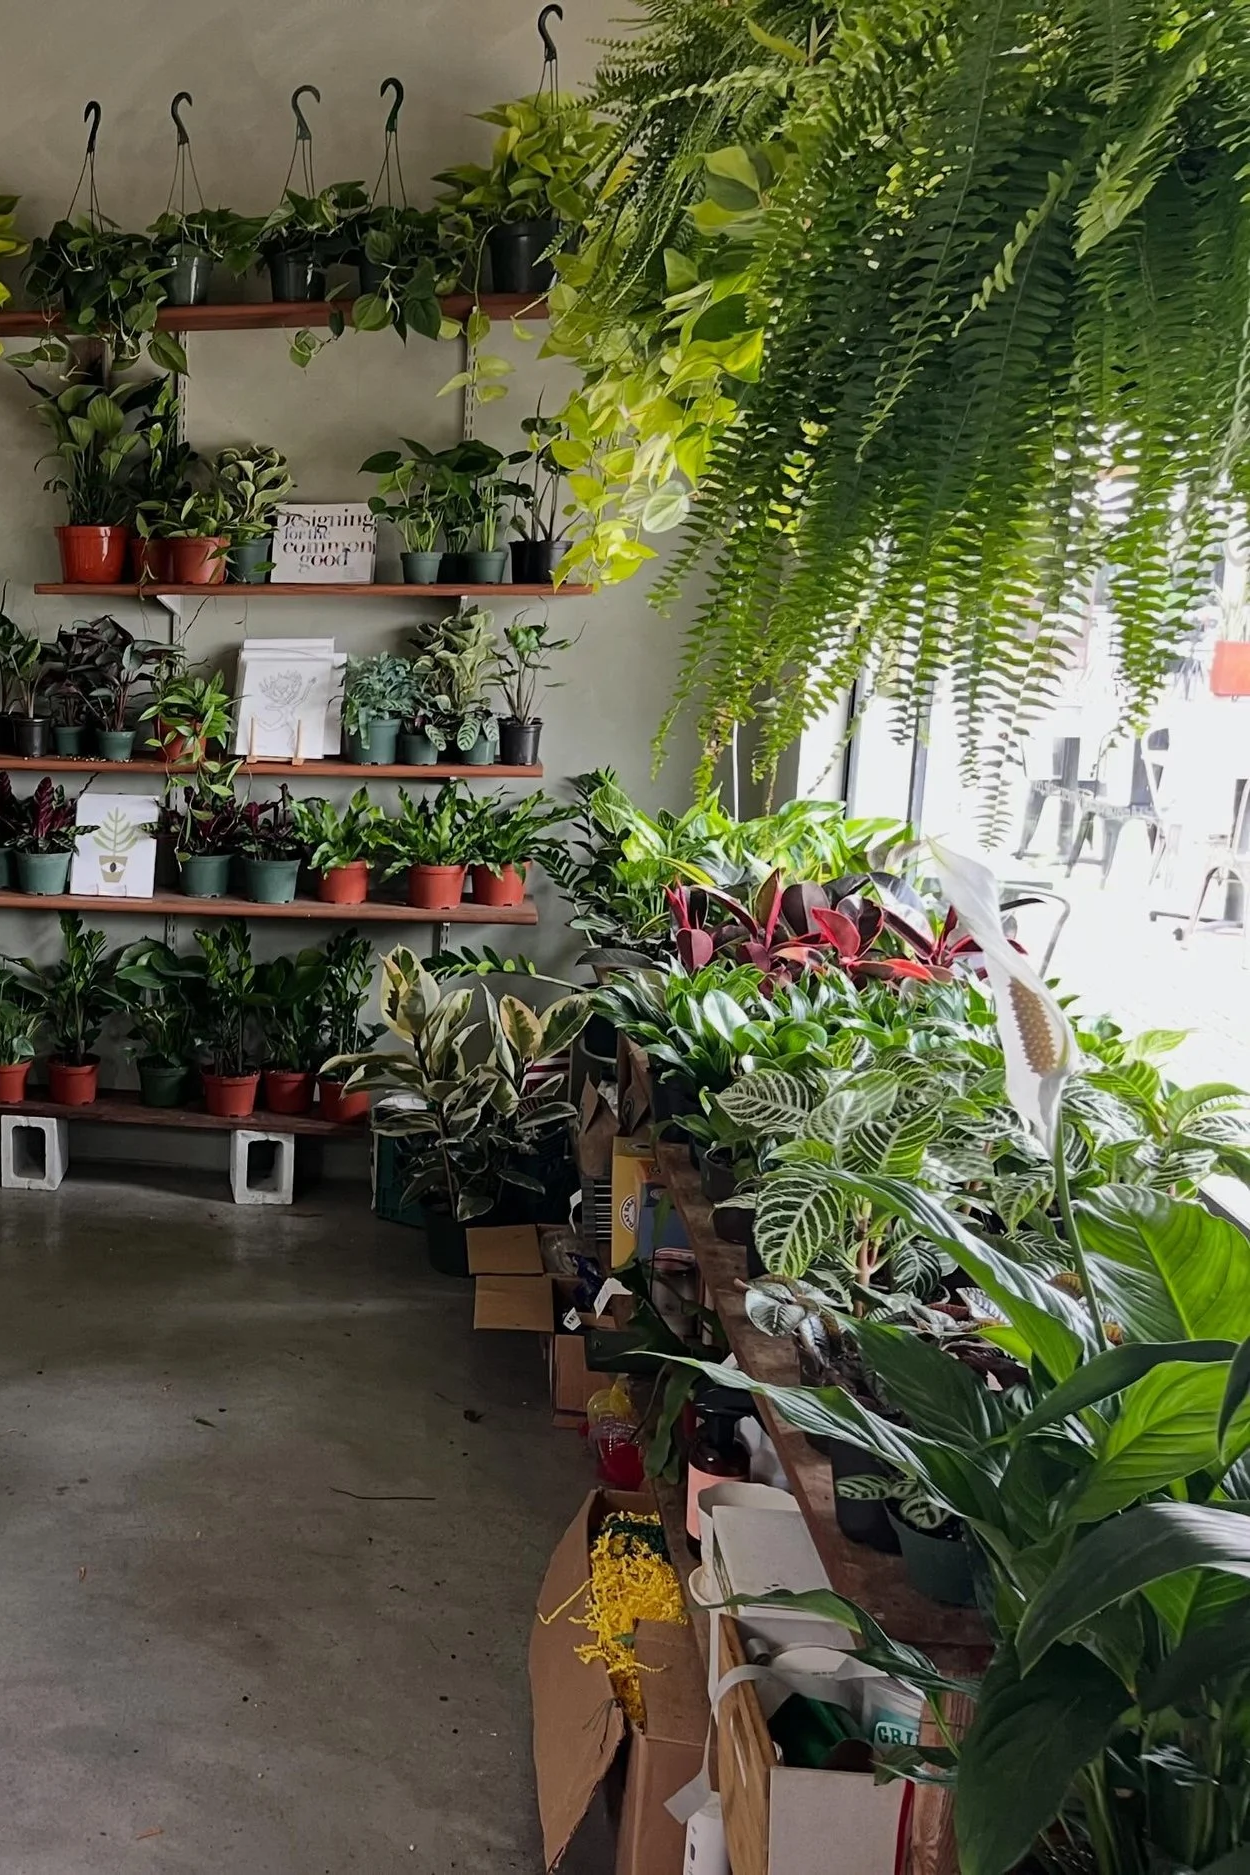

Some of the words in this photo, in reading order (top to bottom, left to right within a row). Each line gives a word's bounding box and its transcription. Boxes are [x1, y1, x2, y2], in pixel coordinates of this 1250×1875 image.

[285, 526, 304, 539] for
[283, 541, 371, 553] common
[299, 548, 350, 574] good
[877, 1726, 919, 1746] GRI
